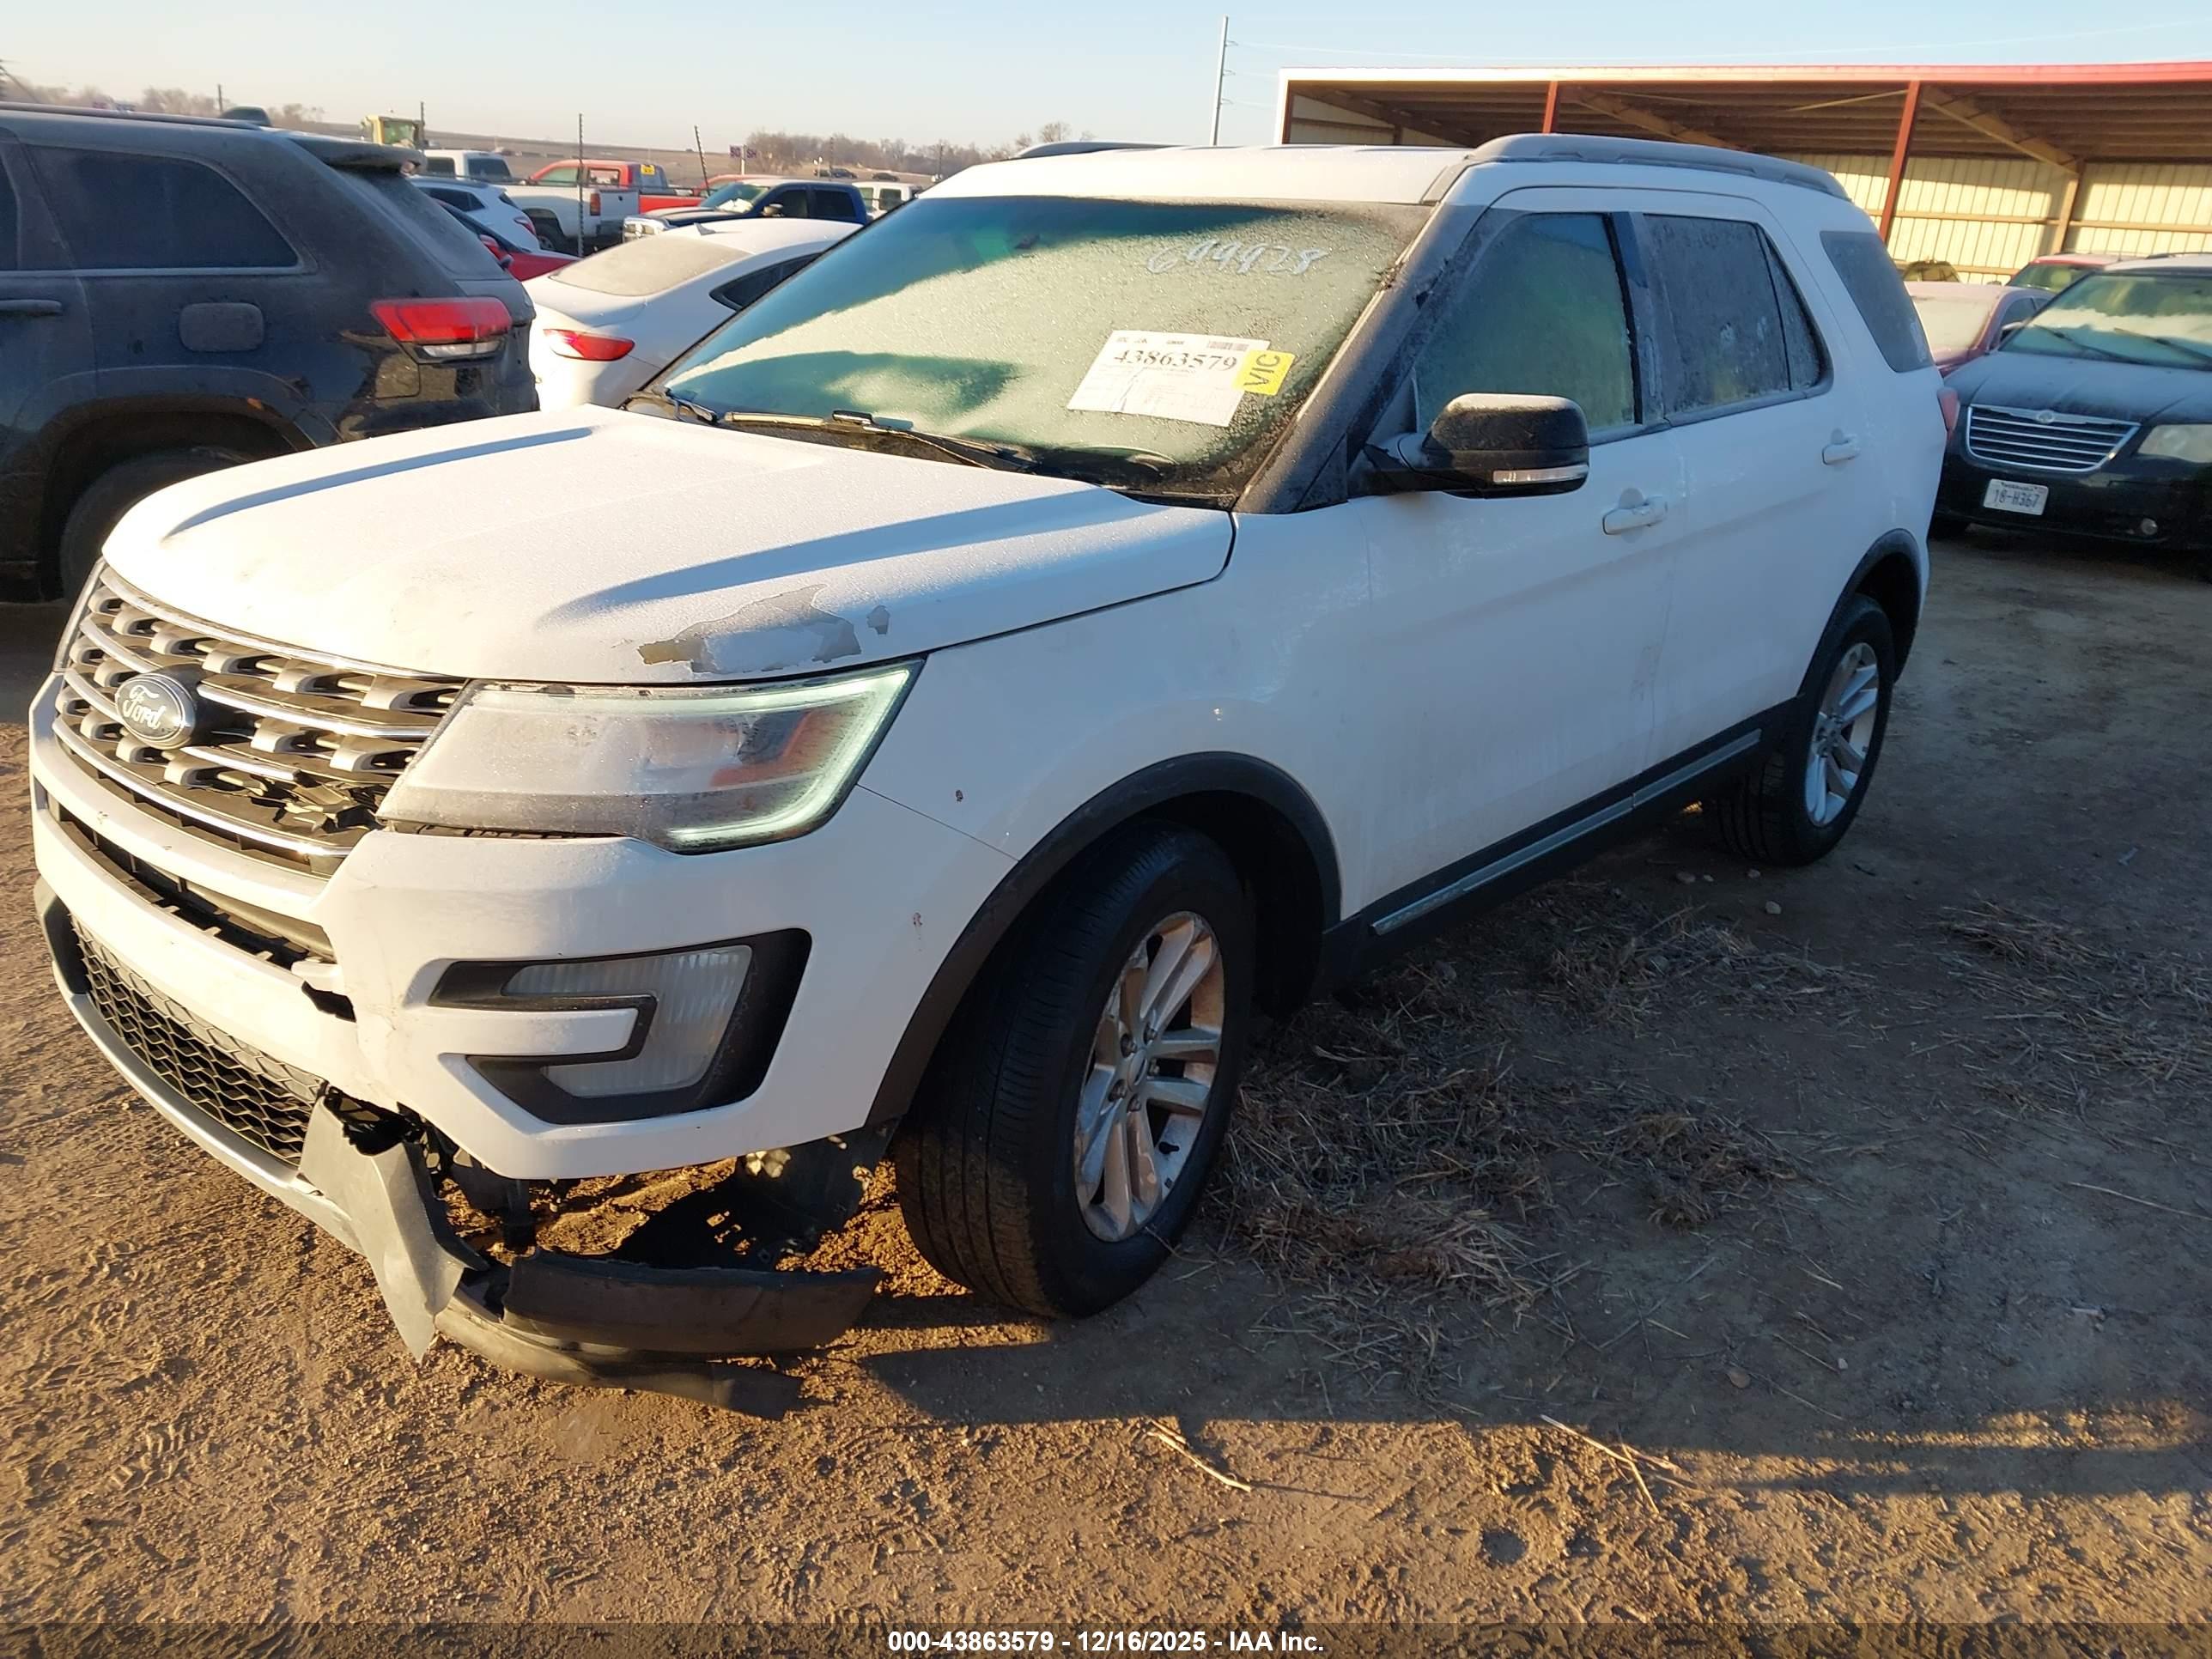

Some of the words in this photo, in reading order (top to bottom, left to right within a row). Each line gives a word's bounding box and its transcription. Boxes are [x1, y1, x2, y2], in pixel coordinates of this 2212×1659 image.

[1114, 349, 1237, 371] 43863579
[1243, 353, 1281, 386] VIC
[122, 684, 167, 730] Ford
